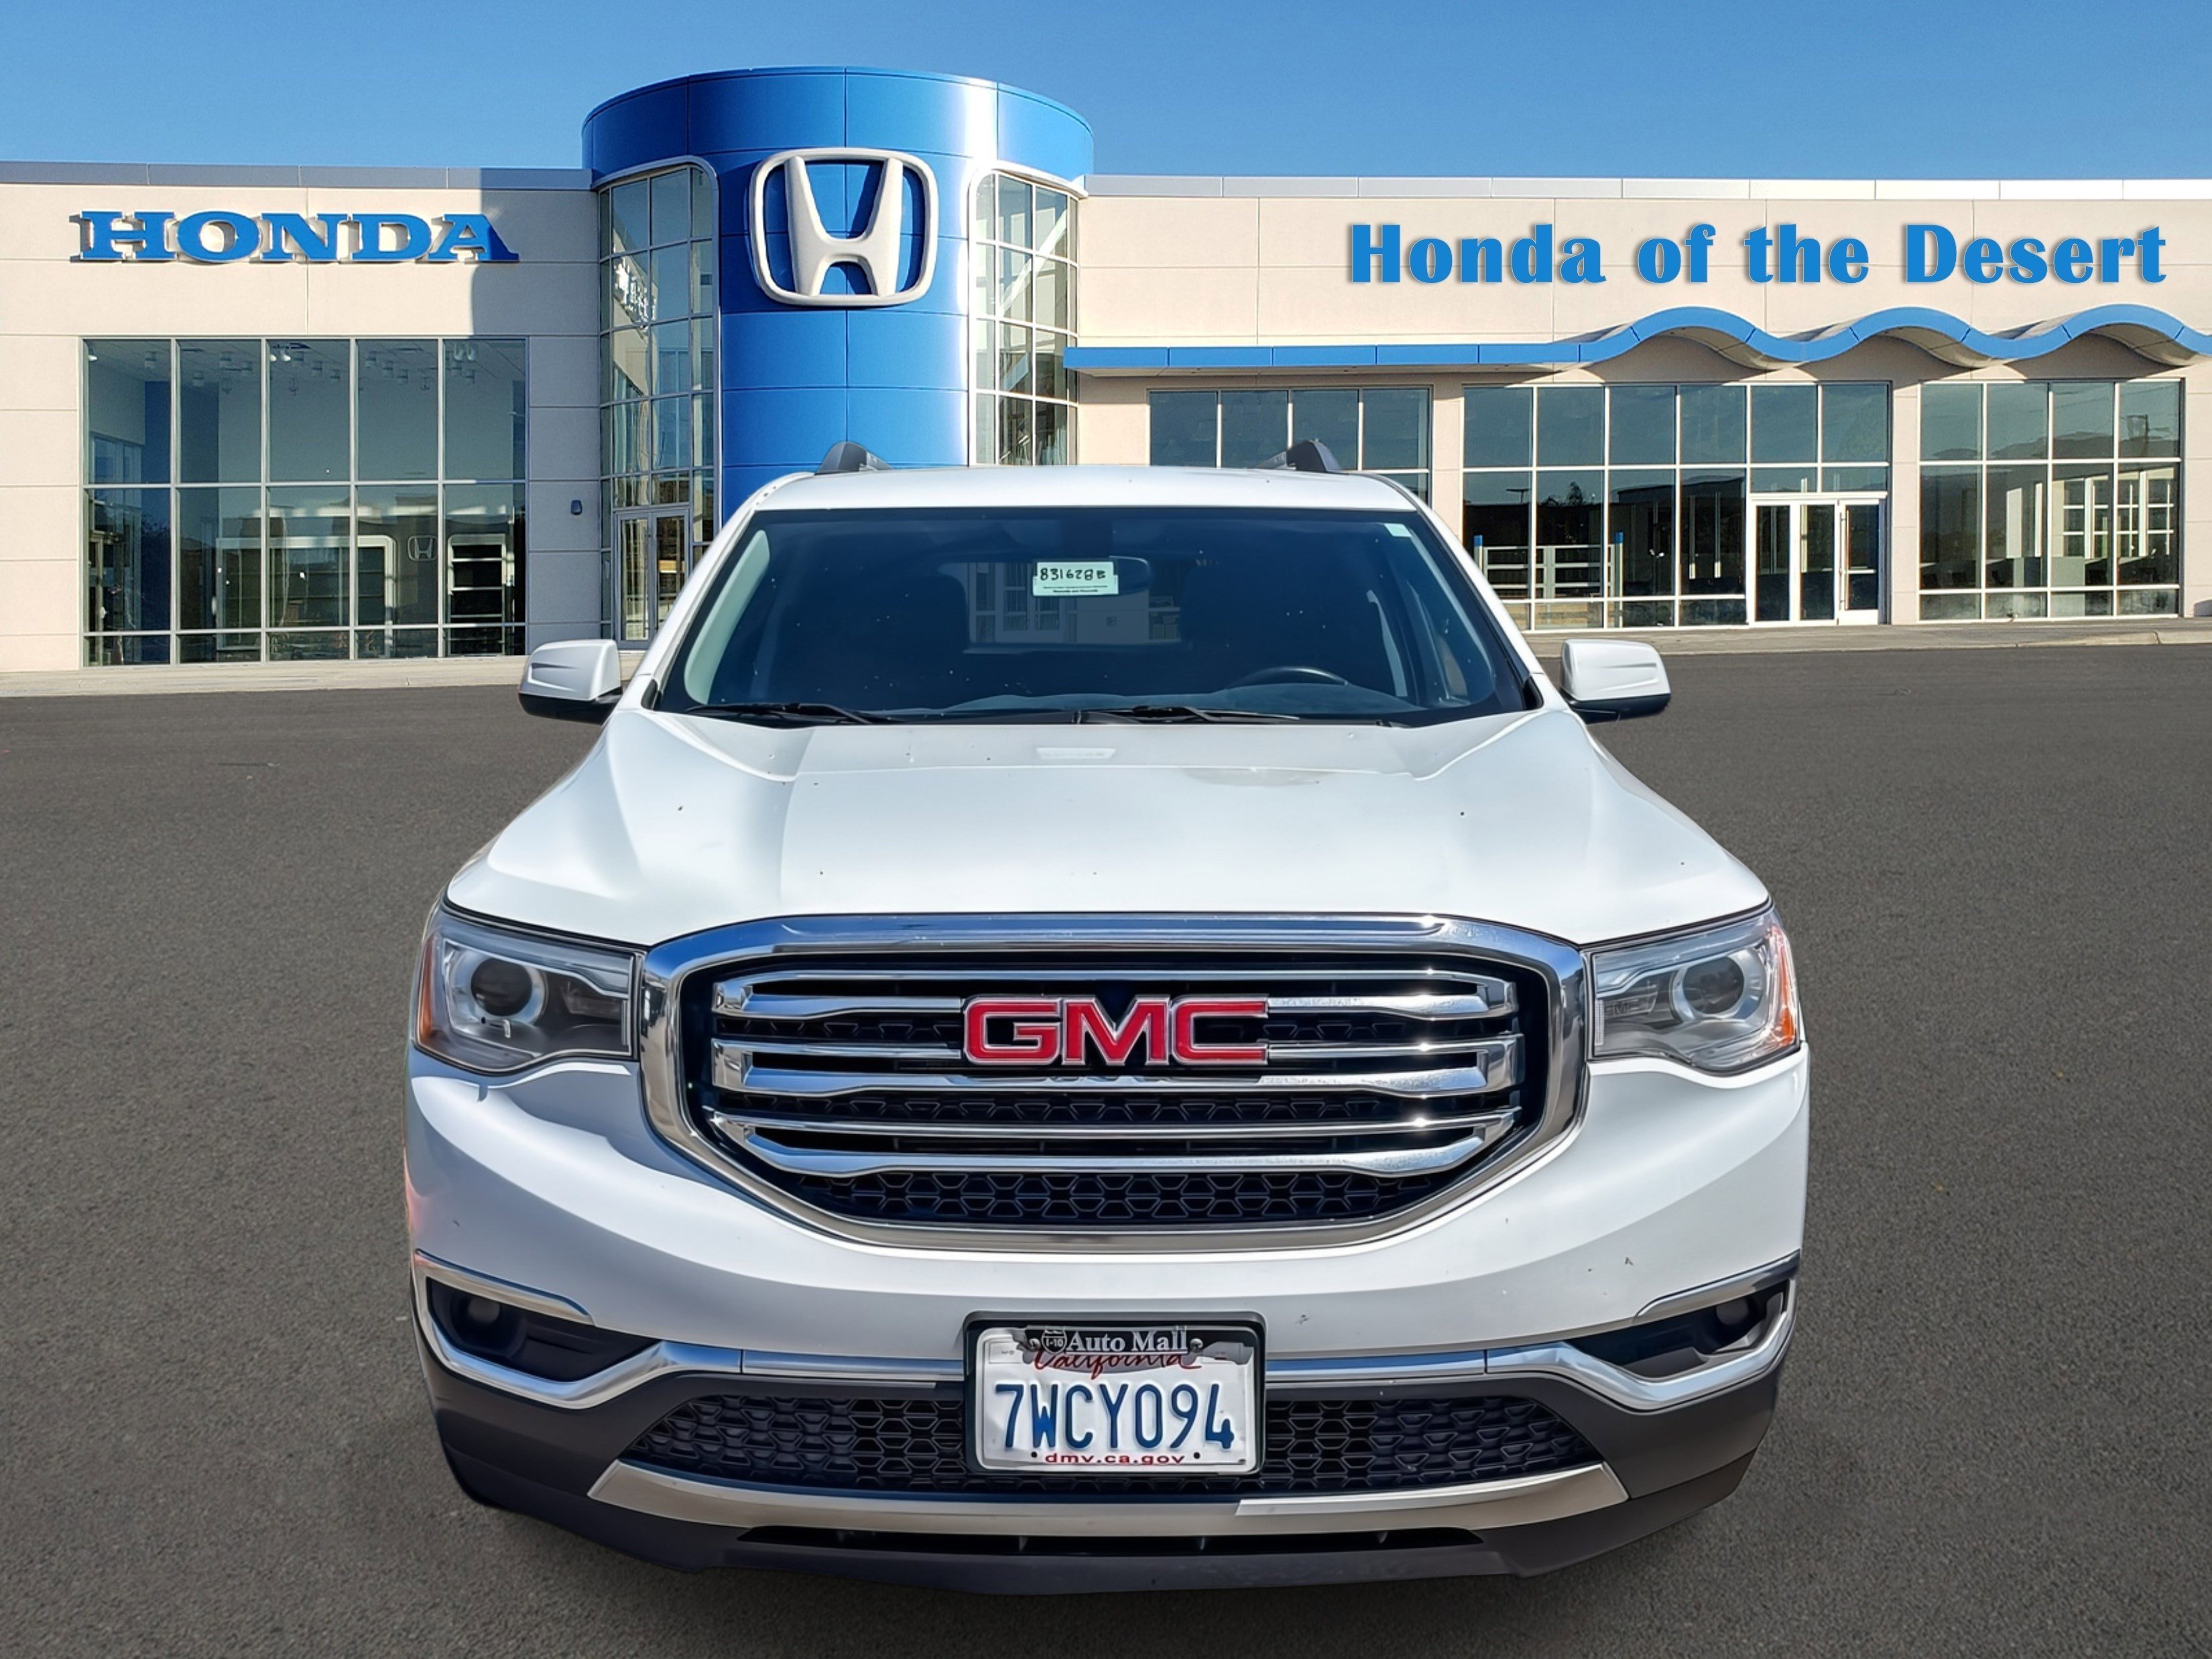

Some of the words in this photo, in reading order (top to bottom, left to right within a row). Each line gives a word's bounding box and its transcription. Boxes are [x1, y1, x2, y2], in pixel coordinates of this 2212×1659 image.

[78, 209, 520, 263] HONDA
[1351, 223, 1607, 284] Honda
[1637, 222, 1717, 284] of
[1743, 223, 1869, 284] the
[1905, 223, 2167, 285] Desert
[964, 994, 1269, 1065] GMC
[1066, 1331, 1125, 1352] Auto
[1130, 1329, 1188, 1352] Mall
[995, 1383, 1235, 1450] 7WCY094
[1044, 1452, 1186, 1465] dmv.ca.gov
